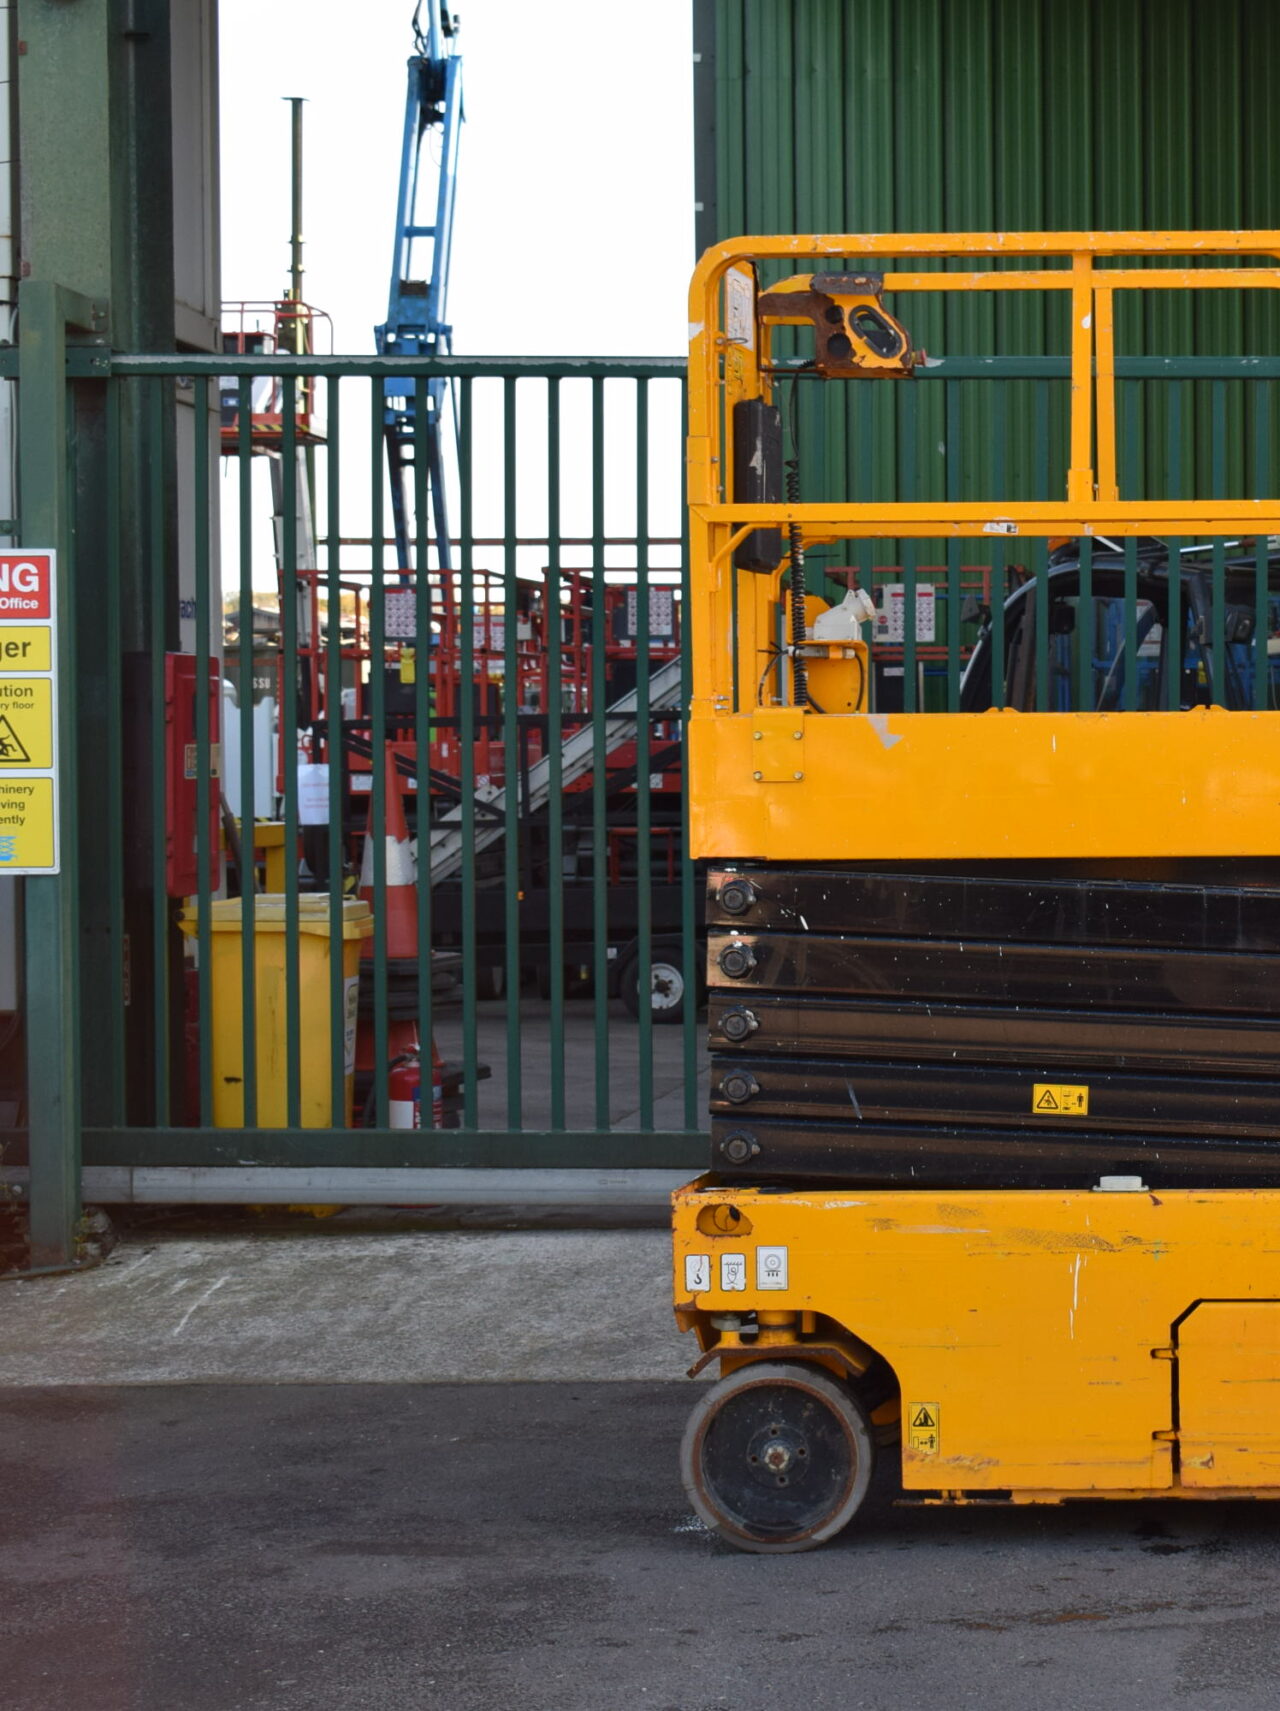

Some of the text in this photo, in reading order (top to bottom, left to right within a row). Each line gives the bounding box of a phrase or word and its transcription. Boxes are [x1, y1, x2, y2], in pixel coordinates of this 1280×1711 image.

[0, 597, 39, 609] Office
[0, 641, 32, 662] er
[0, 685, 34, 698] tion
[13, 701, 35, 709] floor
